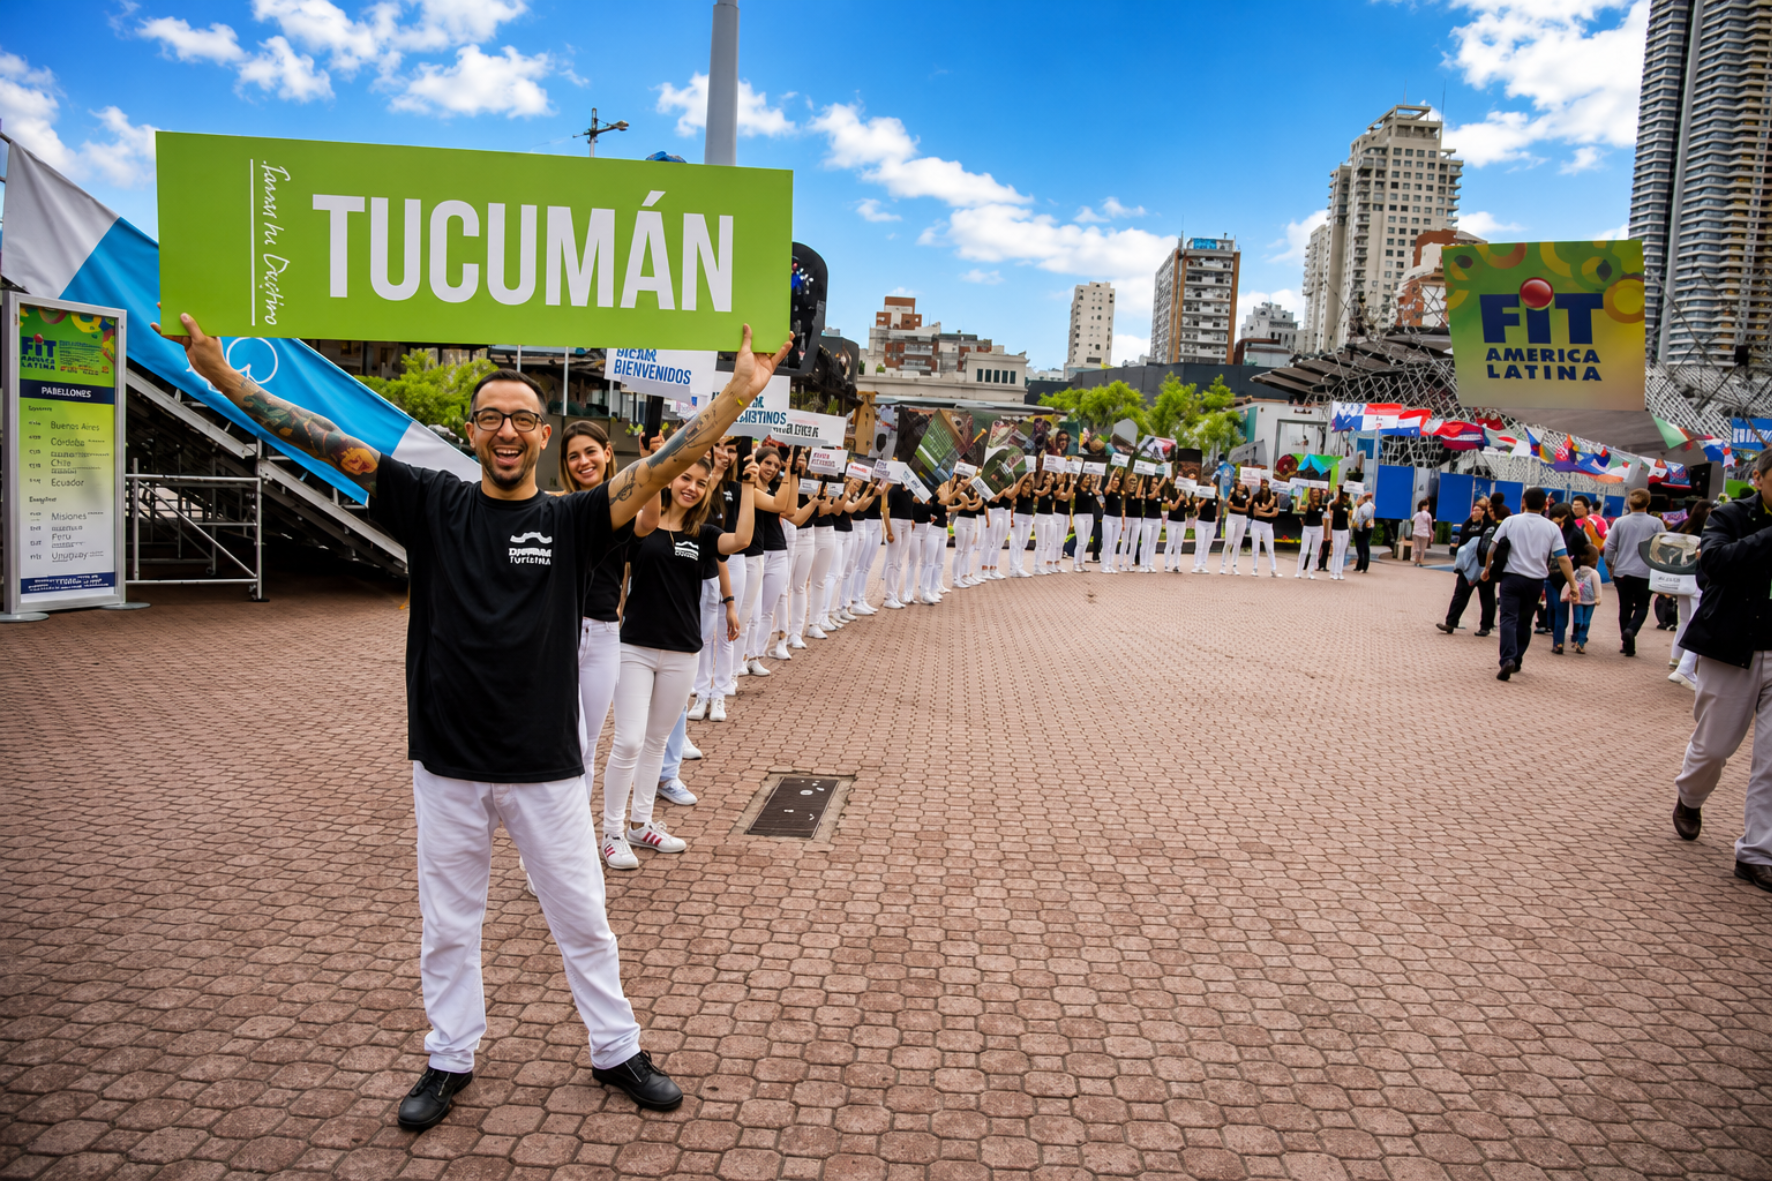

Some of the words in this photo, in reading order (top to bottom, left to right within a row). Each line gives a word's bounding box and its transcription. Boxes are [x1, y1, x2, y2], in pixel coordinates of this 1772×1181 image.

[313, 190, 734, 313] TUCUMÁN
[1485, 347, 1601, 363] AMERICA
[613, 359, 692, 385] BIENVENIDOS
[1487, 364, 1603, 381] LATINA
[50, 420, 79, 430] Buenos
[81, 422, 100, 431] Aires
[51, 478, 84, 487] Ecuador
[51, 512, 87, 521] Misiones
